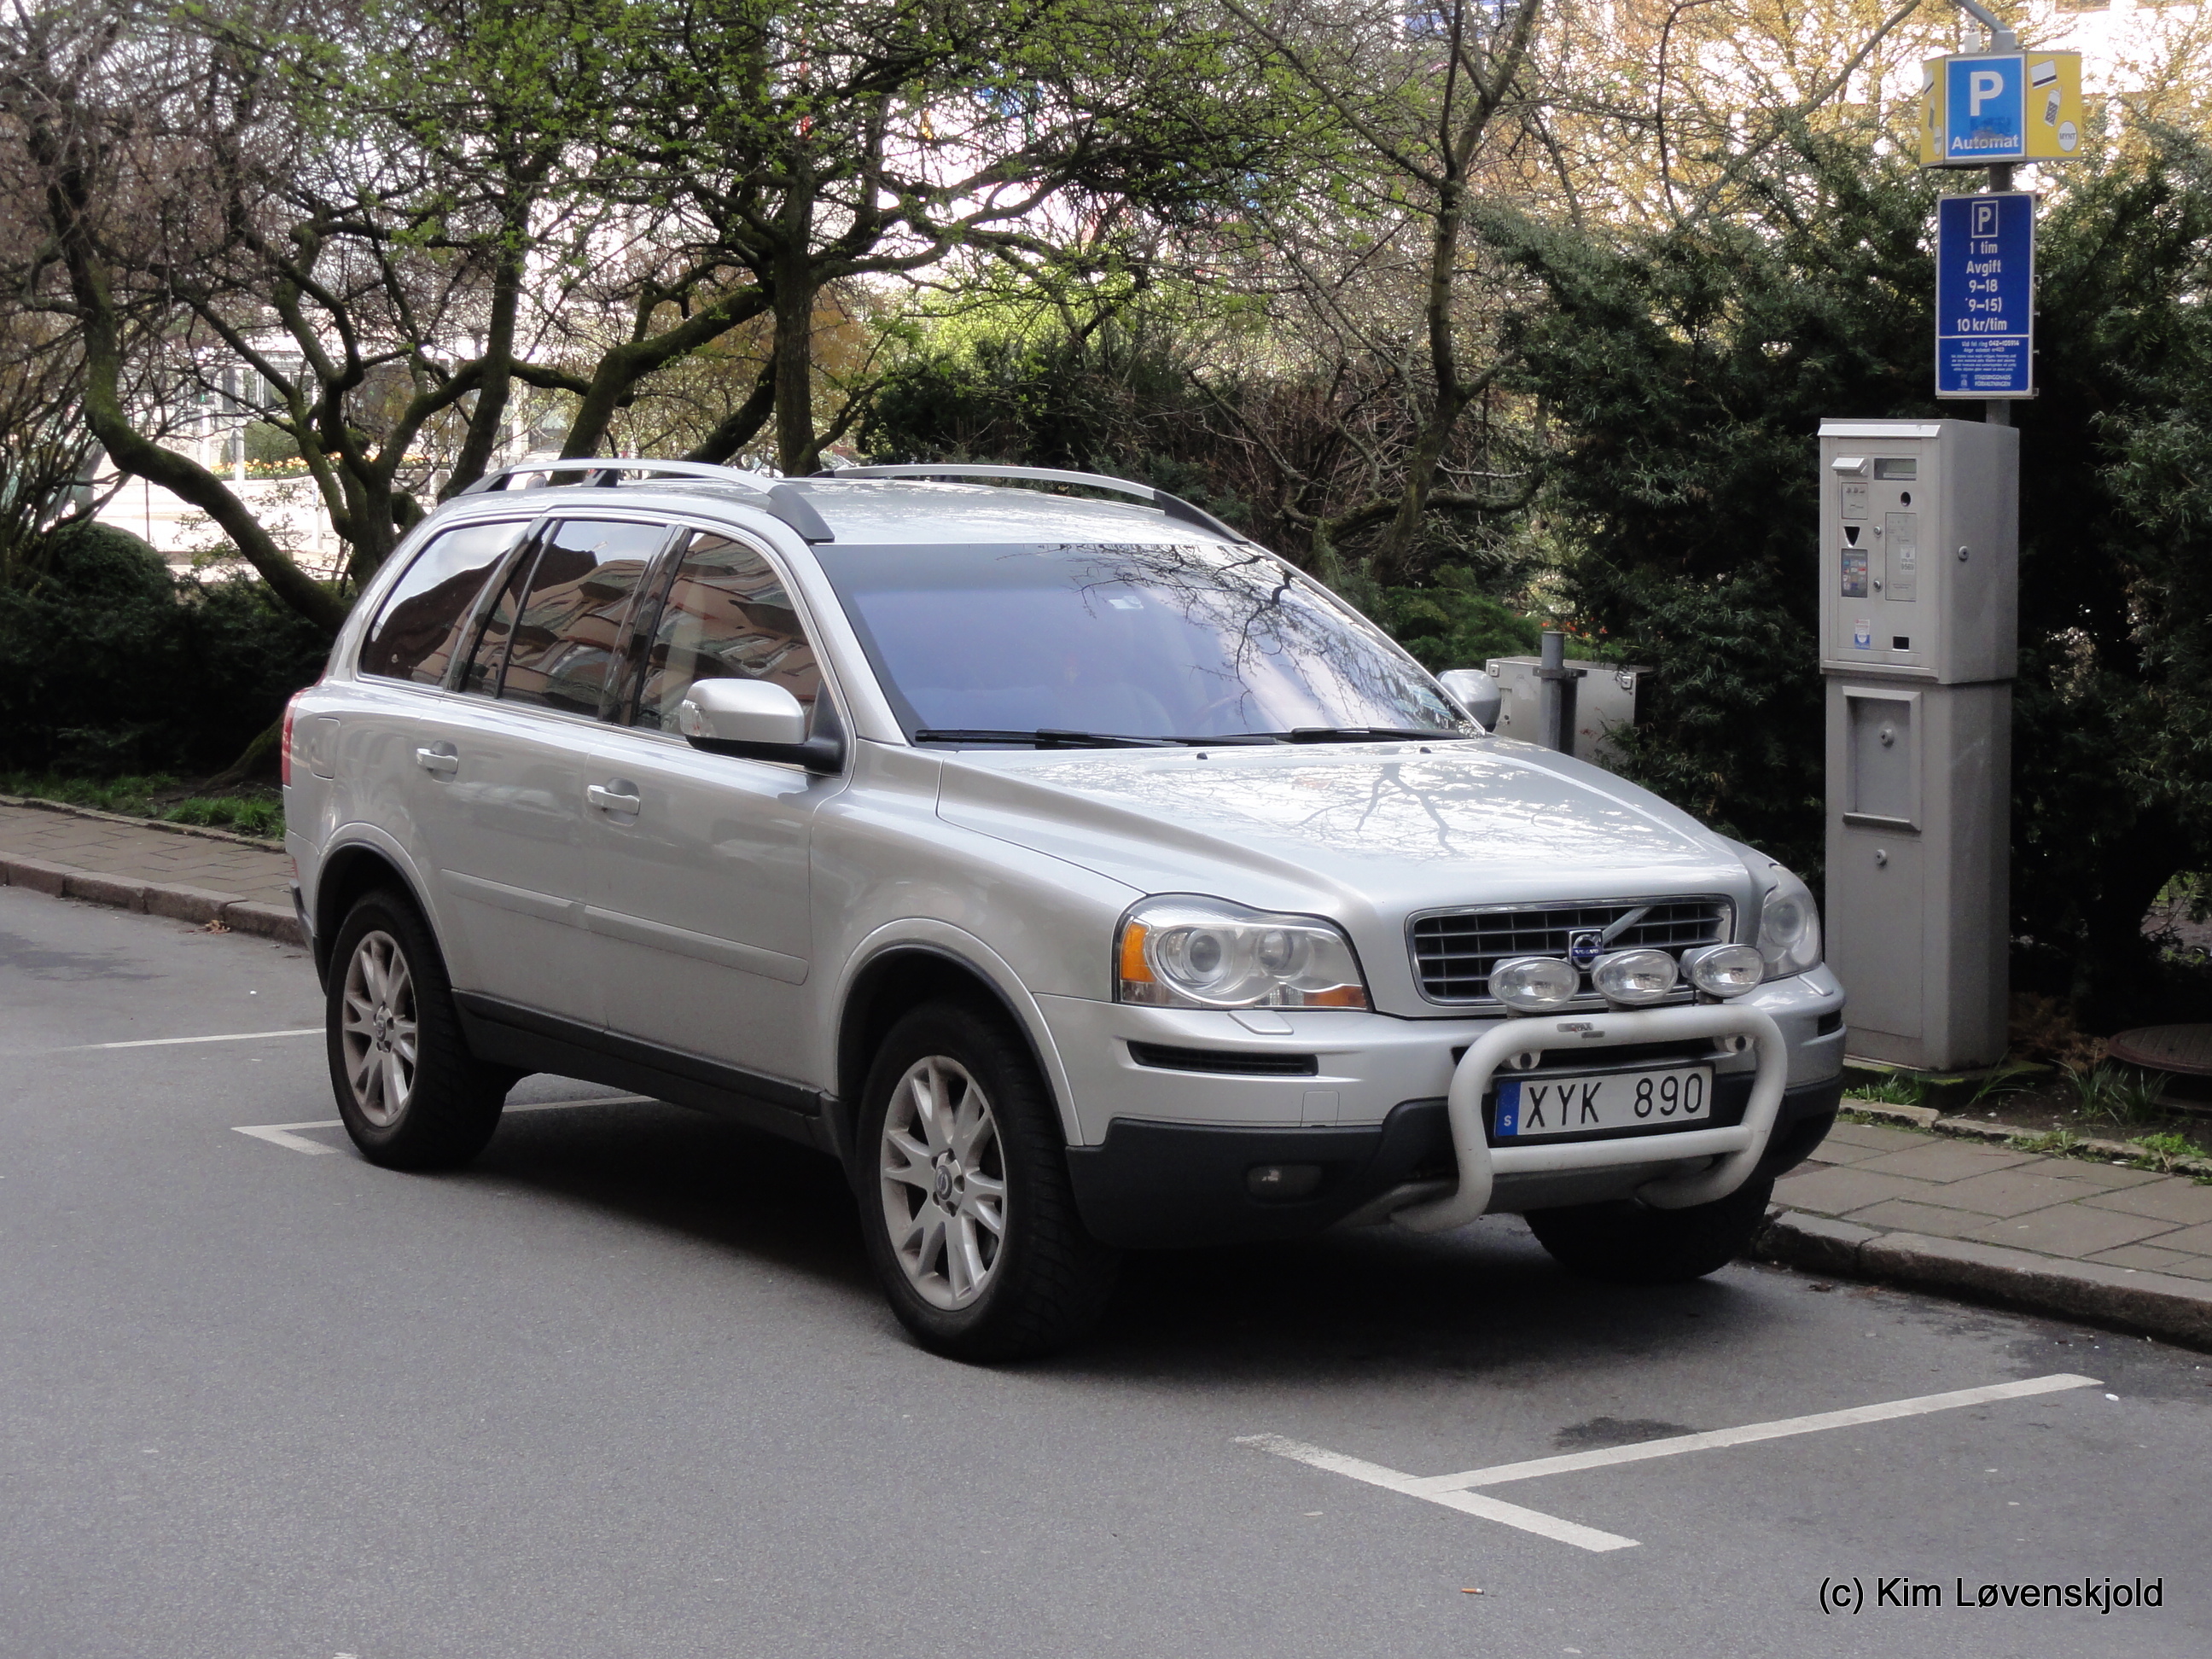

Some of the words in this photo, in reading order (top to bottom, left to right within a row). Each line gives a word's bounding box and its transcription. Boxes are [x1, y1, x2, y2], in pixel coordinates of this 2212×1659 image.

[1970, 71, 2004, 117] P
[1951, 134, 2019, 150] Automat
[1977, 207, 1992, 233] P
[1970, 242, 1974, 254] 1
[1980, 241, 1998, 254] tim
[1966, 260, 2001, 276] Avgift
[1969, 279, 1998, 293] 9-18
[1965, 297, 2002, 313] 9-15)
[1957, 318, 1970, 332] 10
[1972, 317, 2007, 333] kr/tim
[1526, 1081, 1602, 1129] XYK
[1633, 1073, 1703, 1119] 890
[1503, 1115, 1512, 1126] S
